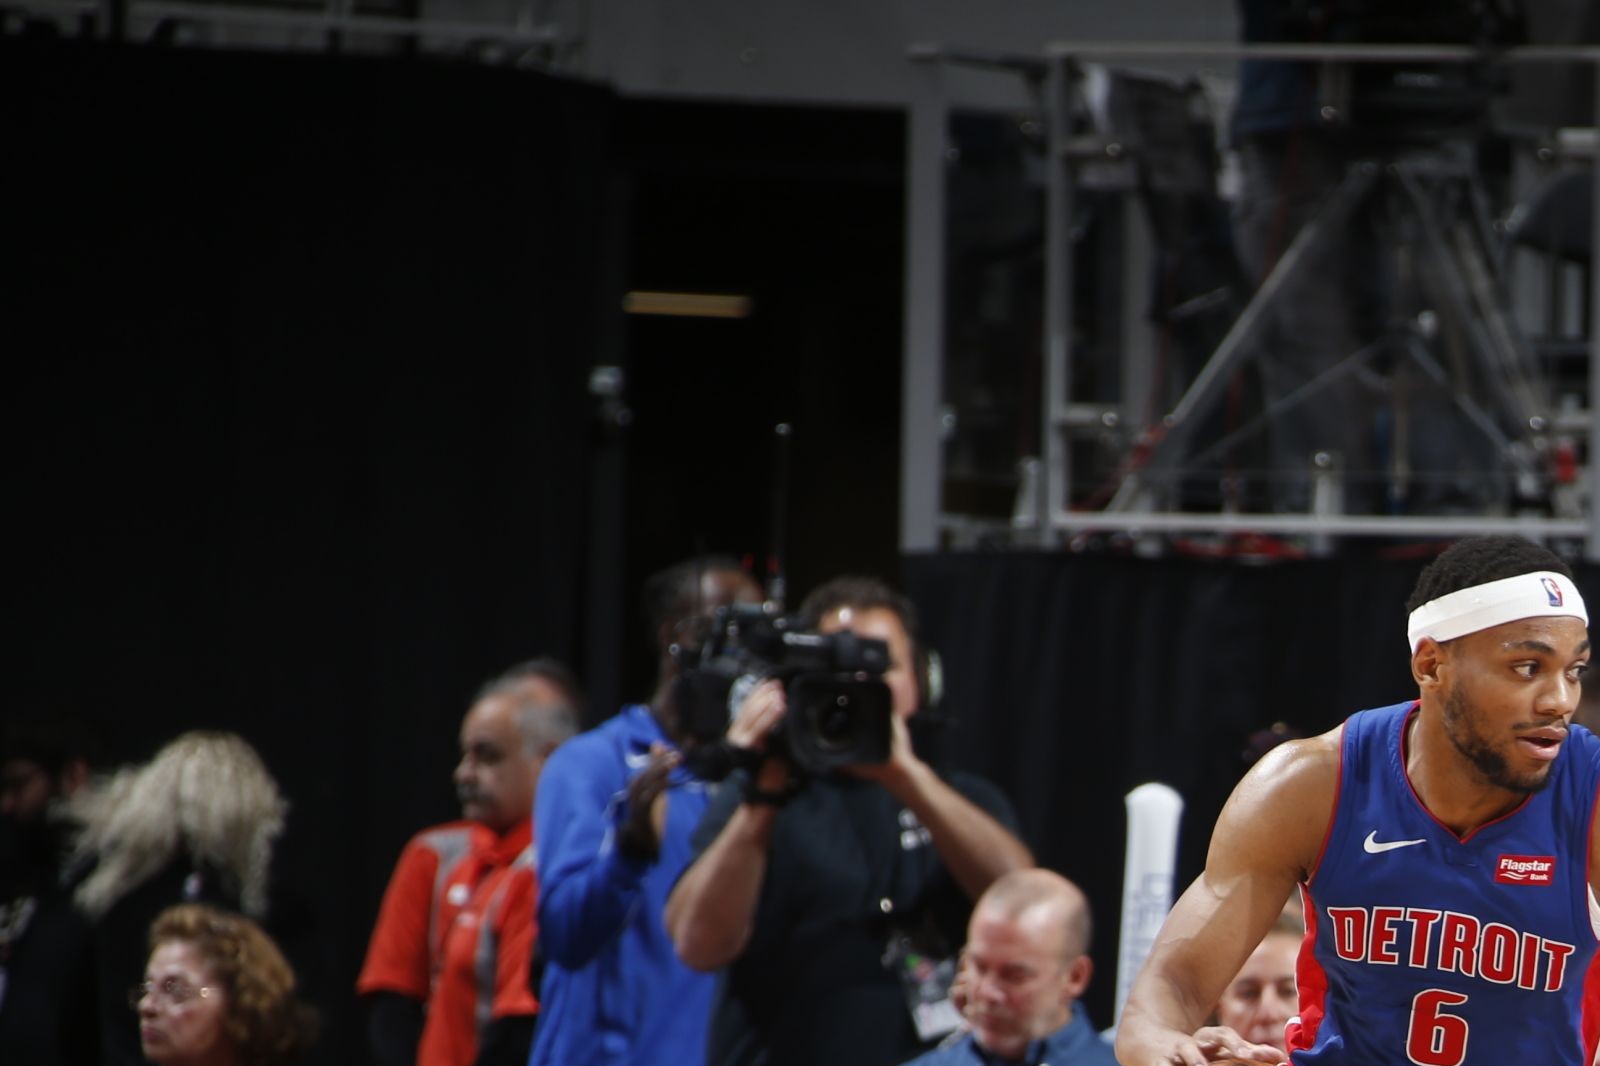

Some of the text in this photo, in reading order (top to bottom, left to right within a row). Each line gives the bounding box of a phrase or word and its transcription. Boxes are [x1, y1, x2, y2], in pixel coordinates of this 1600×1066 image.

[1500, 858, 1552, 873] Flagstar
[1529, 873, 1549, 881] Bank
[1326, 906, 1576, 992] DETROIT
